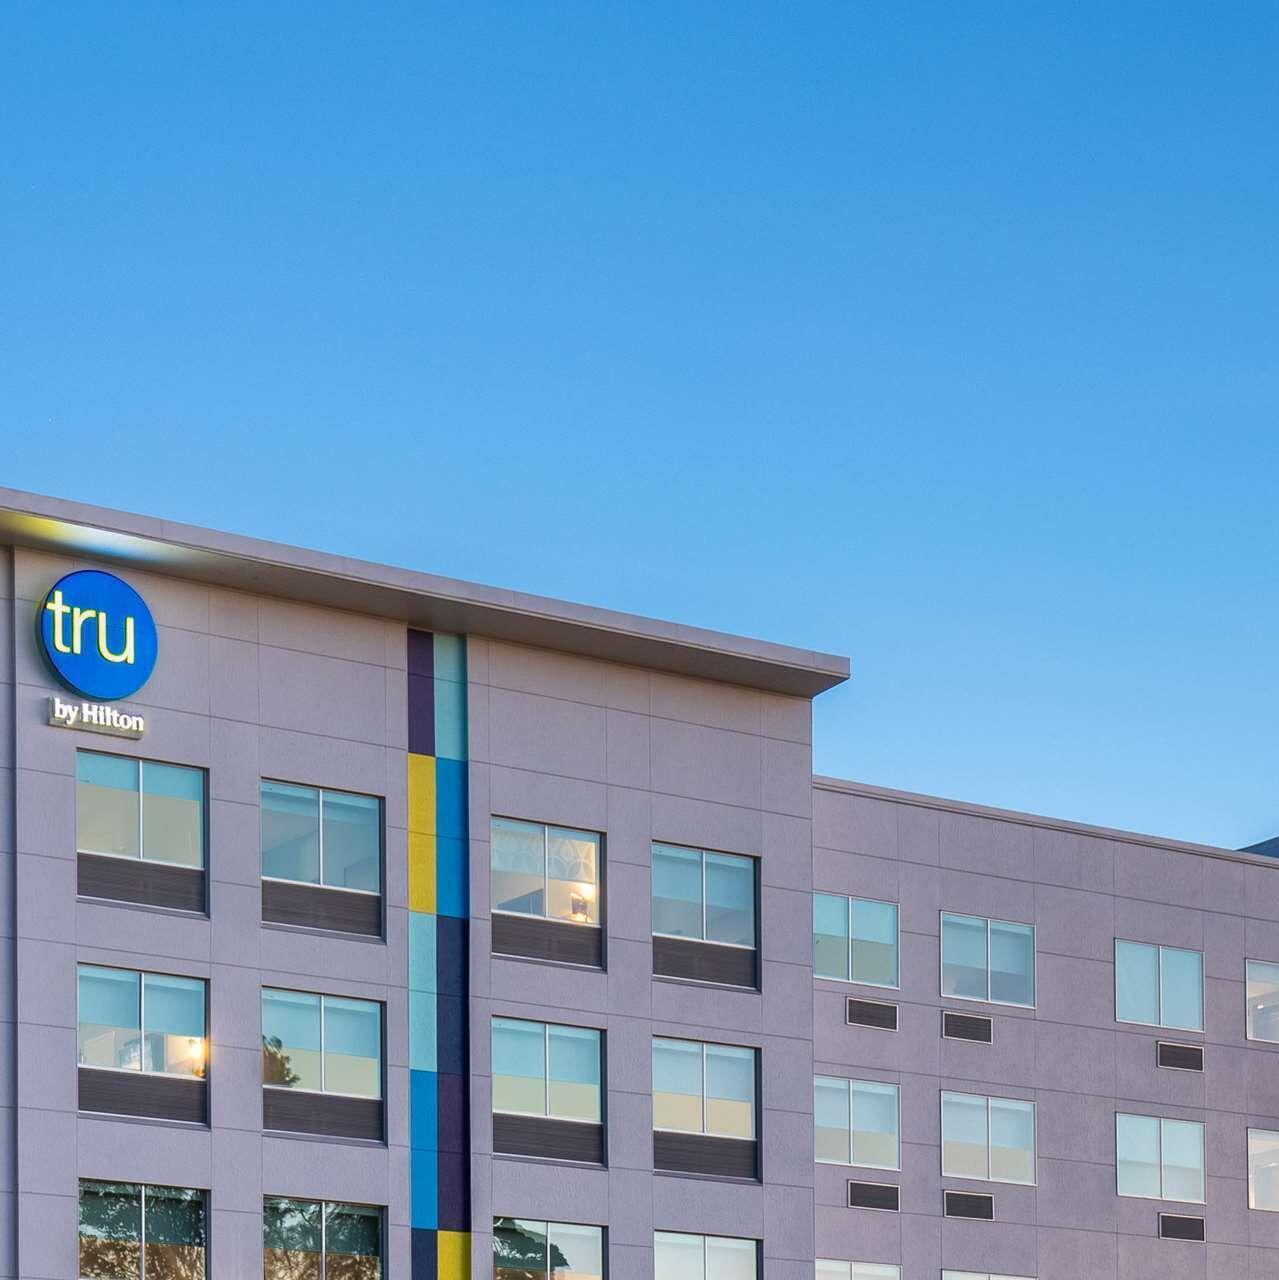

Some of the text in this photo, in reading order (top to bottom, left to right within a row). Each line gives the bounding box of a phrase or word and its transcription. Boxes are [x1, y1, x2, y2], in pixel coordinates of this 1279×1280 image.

[46, 590, 135, 664] tru
[54, 697, 145, 731] by Hilton
